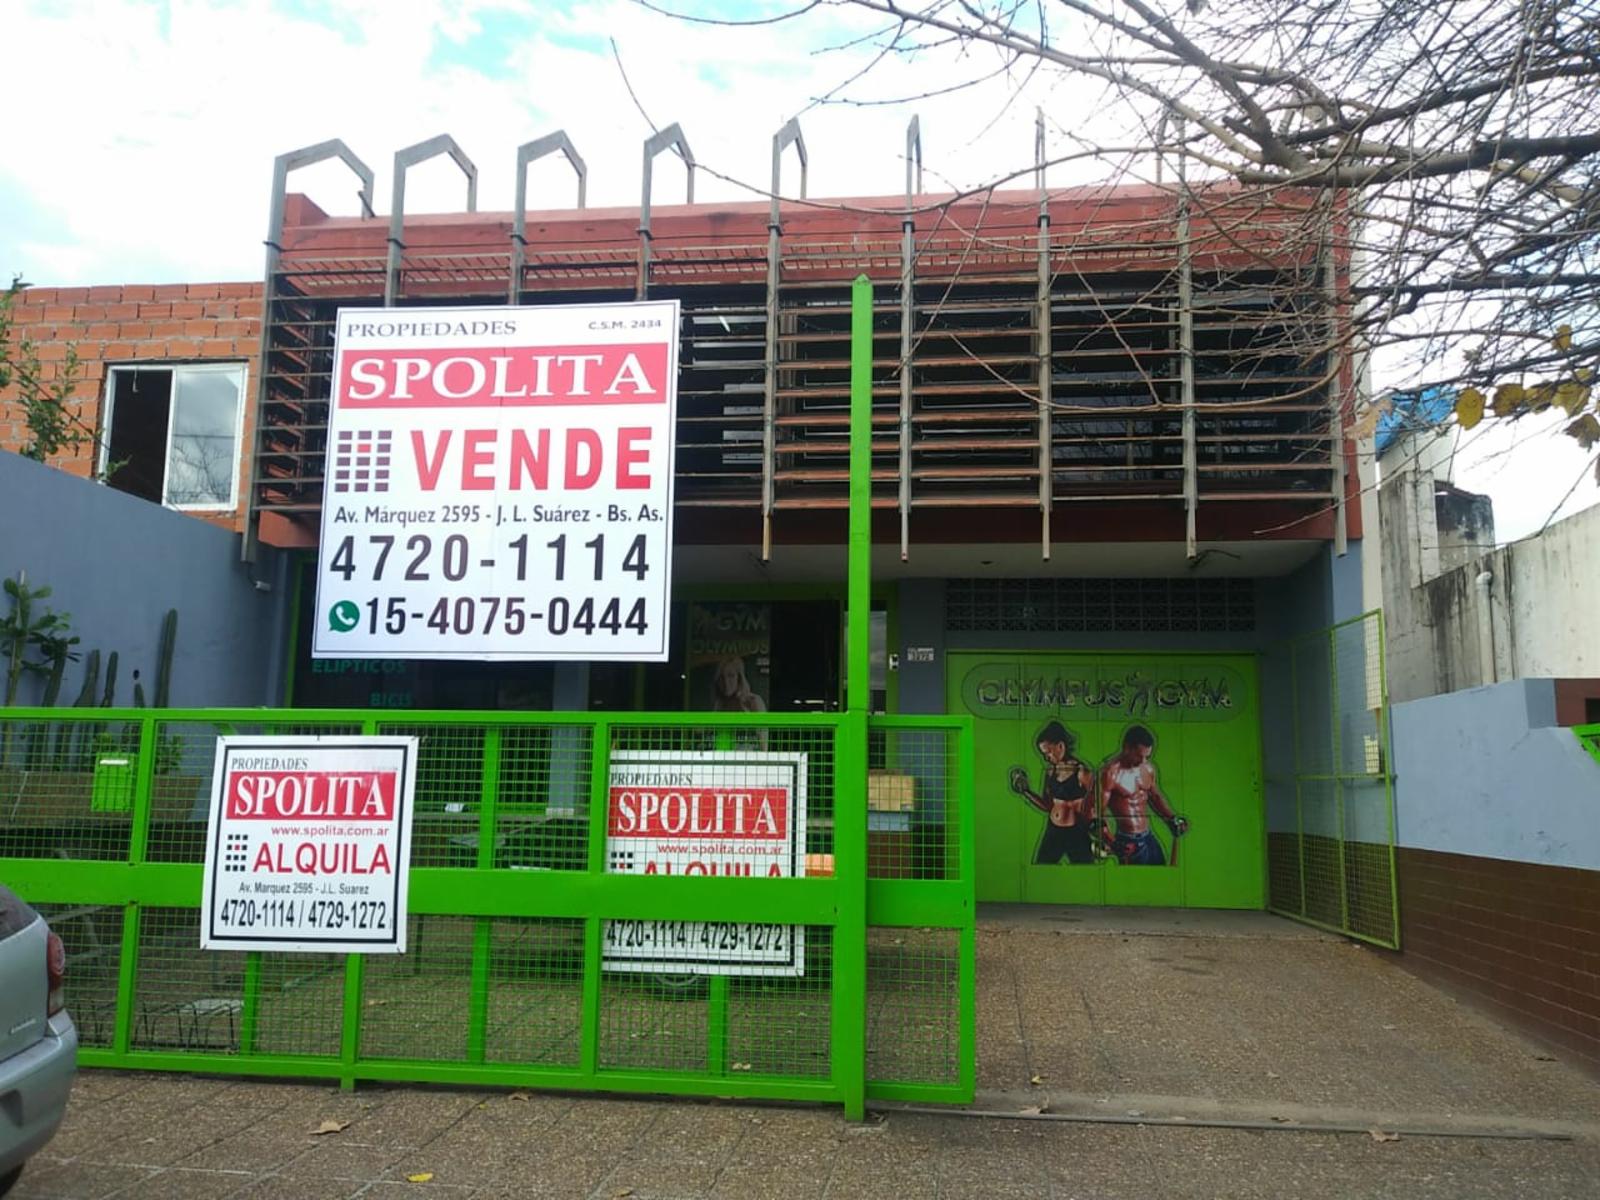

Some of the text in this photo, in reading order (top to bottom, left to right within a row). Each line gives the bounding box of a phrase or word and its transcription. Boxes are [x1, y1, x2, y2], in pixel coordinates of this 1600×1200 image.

[346, 320, 517, 338] PROPIEDADES
[348, 353, 657, 400] SPOLITA
[410, 427, 652, 491] VENDE
[334, 506, 359, 523] Av.
[364, 505, 436, 528] Márquez
[442, 505, 481, 522] 2595
[496, 505, 507, 526] J.
[513, 505, 527, 522] L.
[533, 505, 591, 522] Suárez
[607, 505, 632, 522] Bs.
[637, 504, 664, 522] As.
[329, 534, 650, 581] 4720-1114
[366, 597, 649, 636] 15-4075-0444
[231, 757, 309, 770] PROPIEDADES
[611, 772, 693, 786] PROPIEDADES
[234, 775, 386, 816] SPOLITA
[617, 792, 778, 834] SPOLITA
[271, 824, 389, 837] www.spolita.com.ar
[253, 842, 391, 875] ALQUILA
[657, 843, 783, 856] www.spolita.com.ar
[238, 881, 252, 893] Av.
[254, 882, 291, 895] Marquez
[292, 882, 313, 894] 2595
[338, 883, 370, 895] Suarez
[220, 899, 295, 928] 4720-1114
[308, 900, 387, 929] 4729-1272
[606, 919, 687, 947] 4720-1114
[700, 922, 783, 950] 4729-1272
